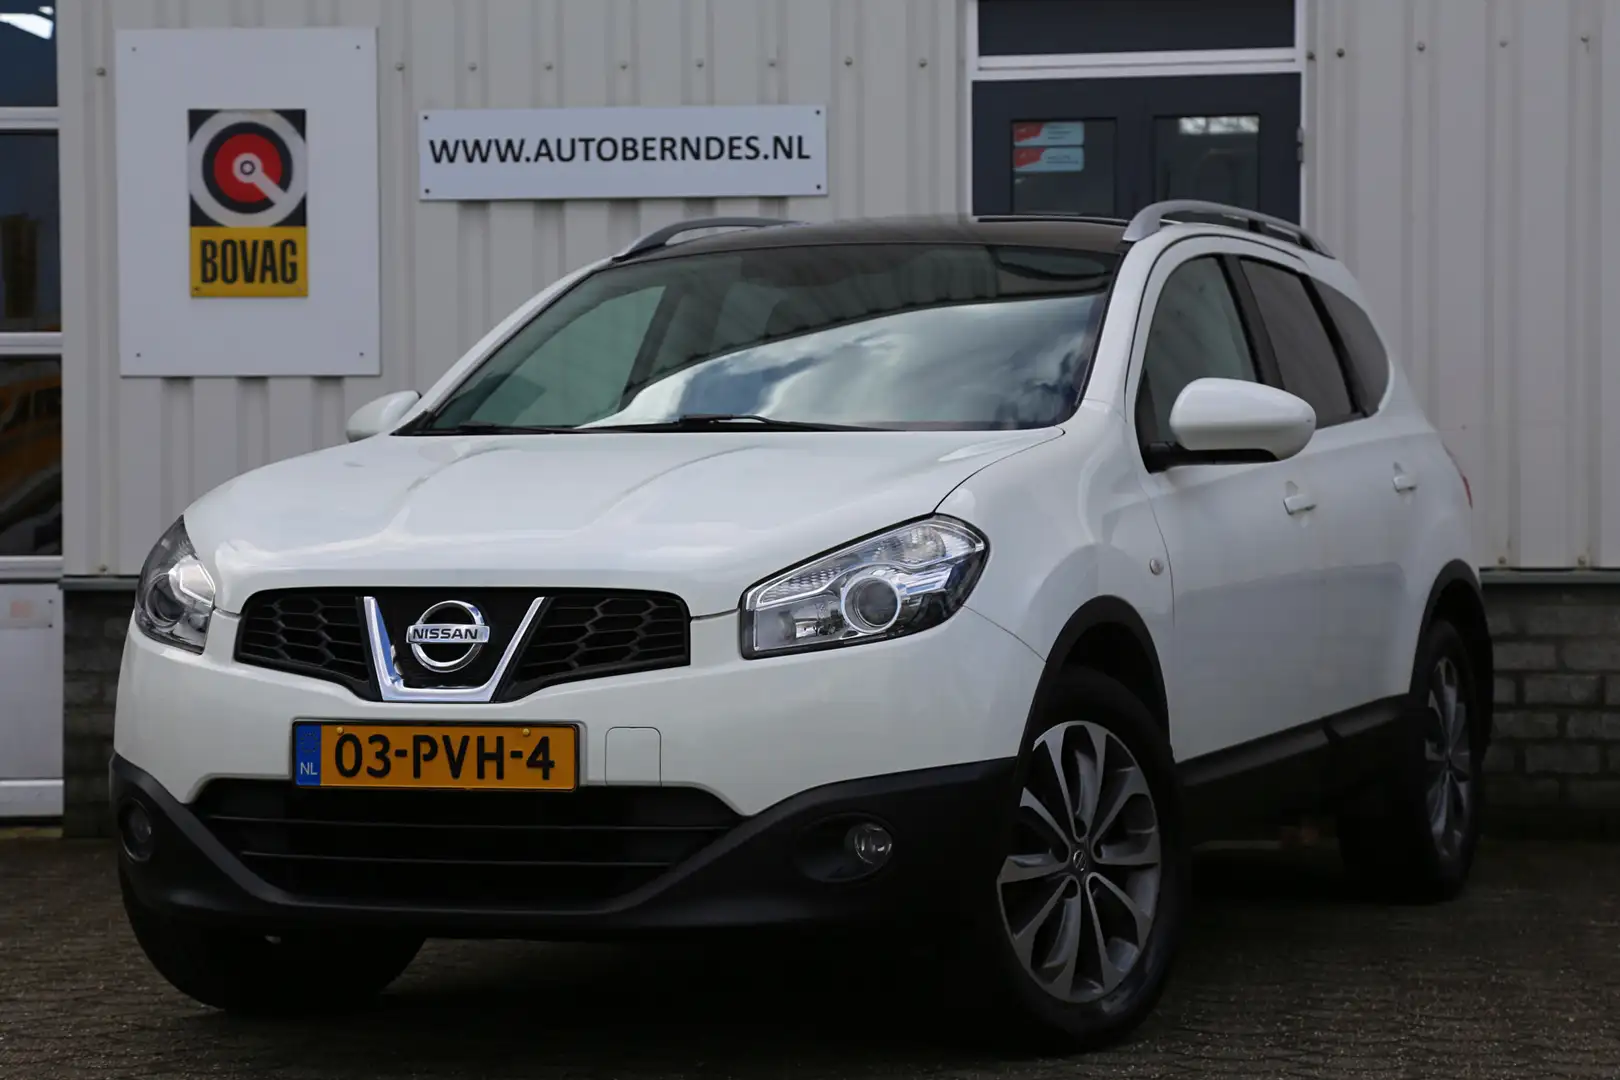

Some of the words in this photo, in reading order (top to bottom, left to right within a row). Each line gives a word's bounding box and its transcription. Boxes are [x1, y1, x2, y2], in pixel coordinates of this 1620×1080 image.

[429, 135, 811, 164] WWW.AUTOBERNDES.NL
[201, 238, 298, 285] BOVAG
[412, 628, 478, 640] NISSAN
[300, 762, 318, 776] NL
[334, 733, 555, 781] 03-PVH-4
